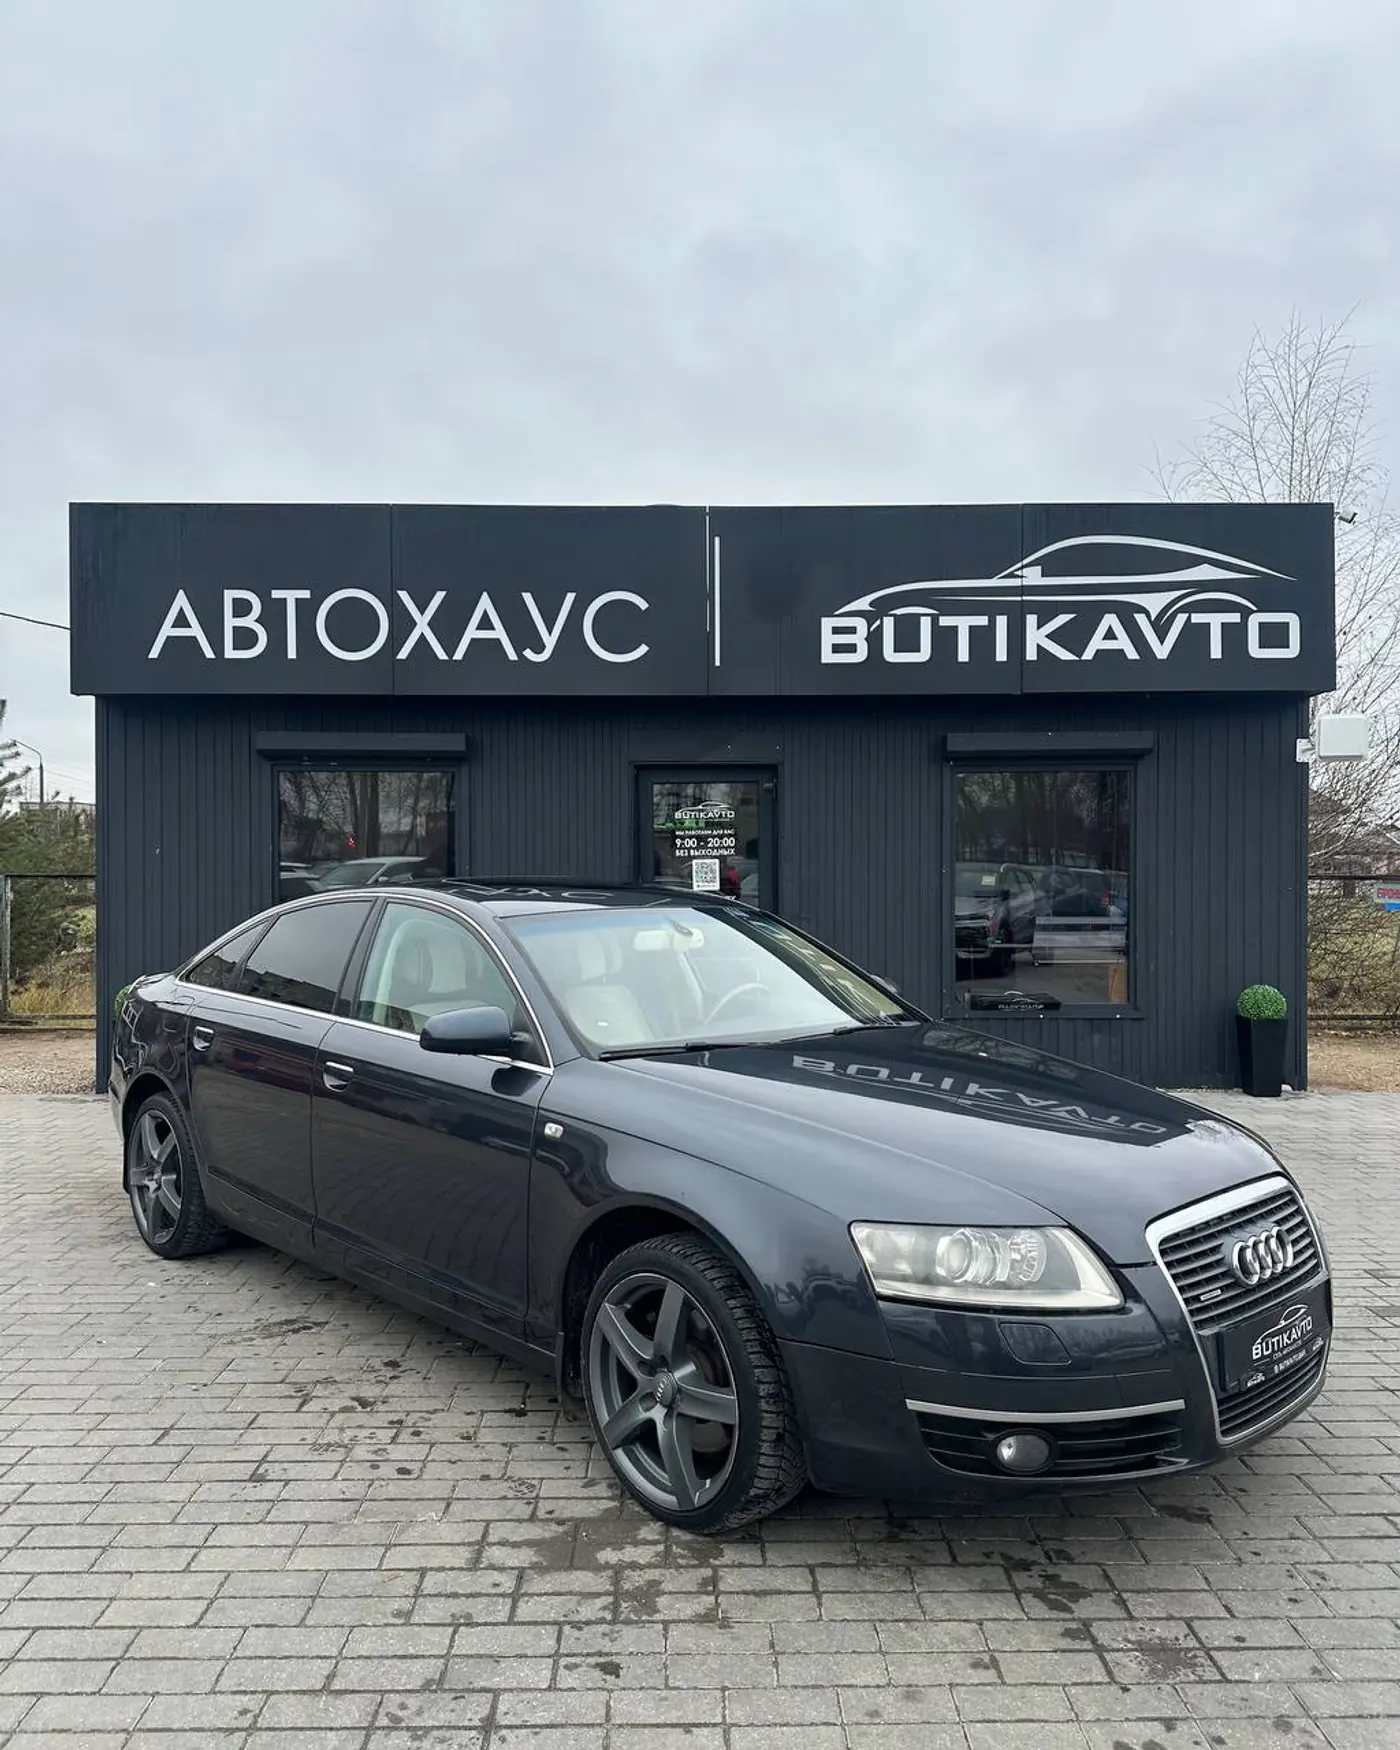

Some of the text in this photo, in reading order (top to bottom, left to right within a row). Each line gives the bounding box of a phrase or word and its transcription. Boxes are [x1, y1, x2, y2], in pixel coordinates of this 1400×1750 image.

[147, 588, 650, 663] АВТОХАУС
[820, 612, 1301, 664] BUTIKAVTO
[675, 810, 735, 819] BUTIKAVTO
[675, 838, 697, 848] 9:00
[707, 837, 735, 848] 20:00
[1252, 1316, 1312, 1360] BUTIKAVTO
